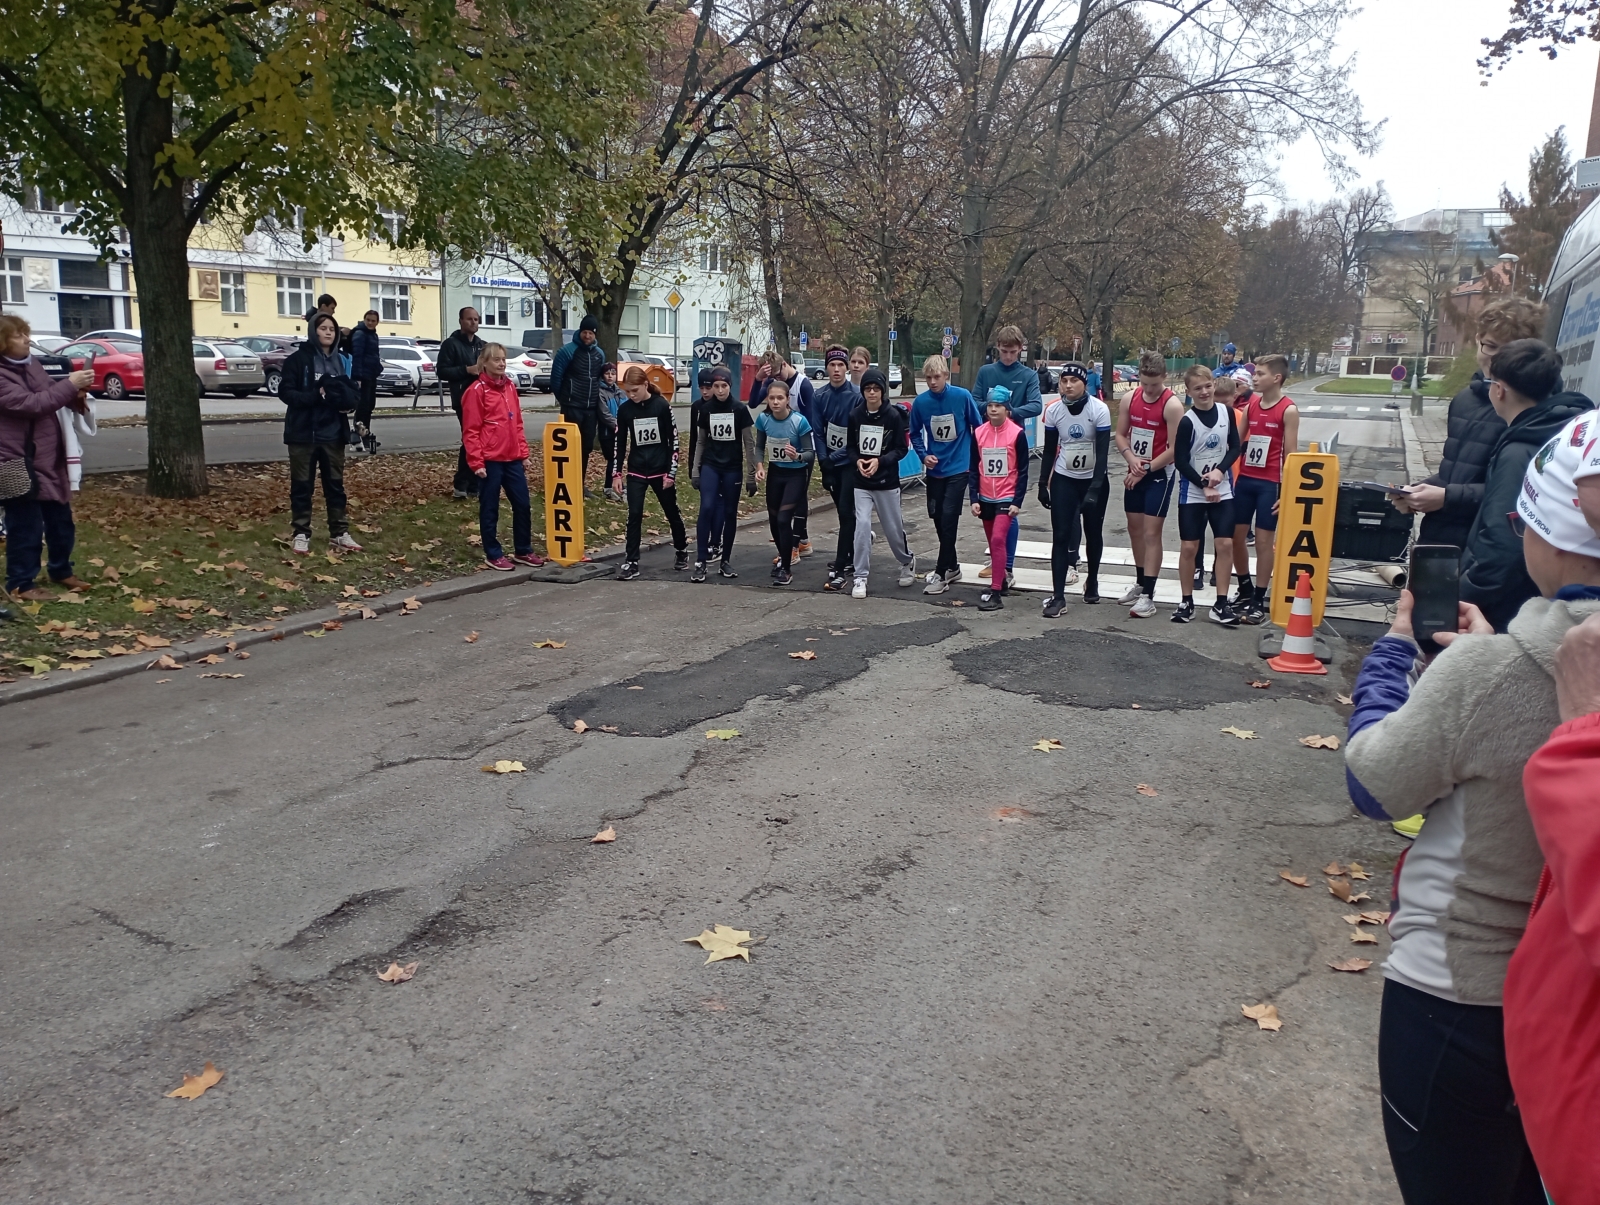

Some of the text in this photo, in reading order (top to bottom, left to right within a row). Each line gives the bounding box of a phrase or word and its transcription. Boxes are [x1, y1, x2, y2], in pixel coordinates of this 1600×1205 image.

[471, 276, 489, 285] D.A.S.
[490, 278, 520, 288] pojišťovna
[638, 428, 657, 442] 136
[713, 423, 732, 437] 134
[936, 425, 951, 439] 47
[830, 434, 844, 448] 56
[862, 436, 877, 451] 60
[1133, 439, 1149, 455] 48
[772, 447, 786, 459] 50
[1249, 447, 1263, 463] 49
[987, 458, 1003, 474] 59
[1072, 454, 1087, 469] 61
[551, 427, 573, 559] START
[1527, 511, 1536, 520] DO
[1534, 517, 1551, 535] VRCHU
